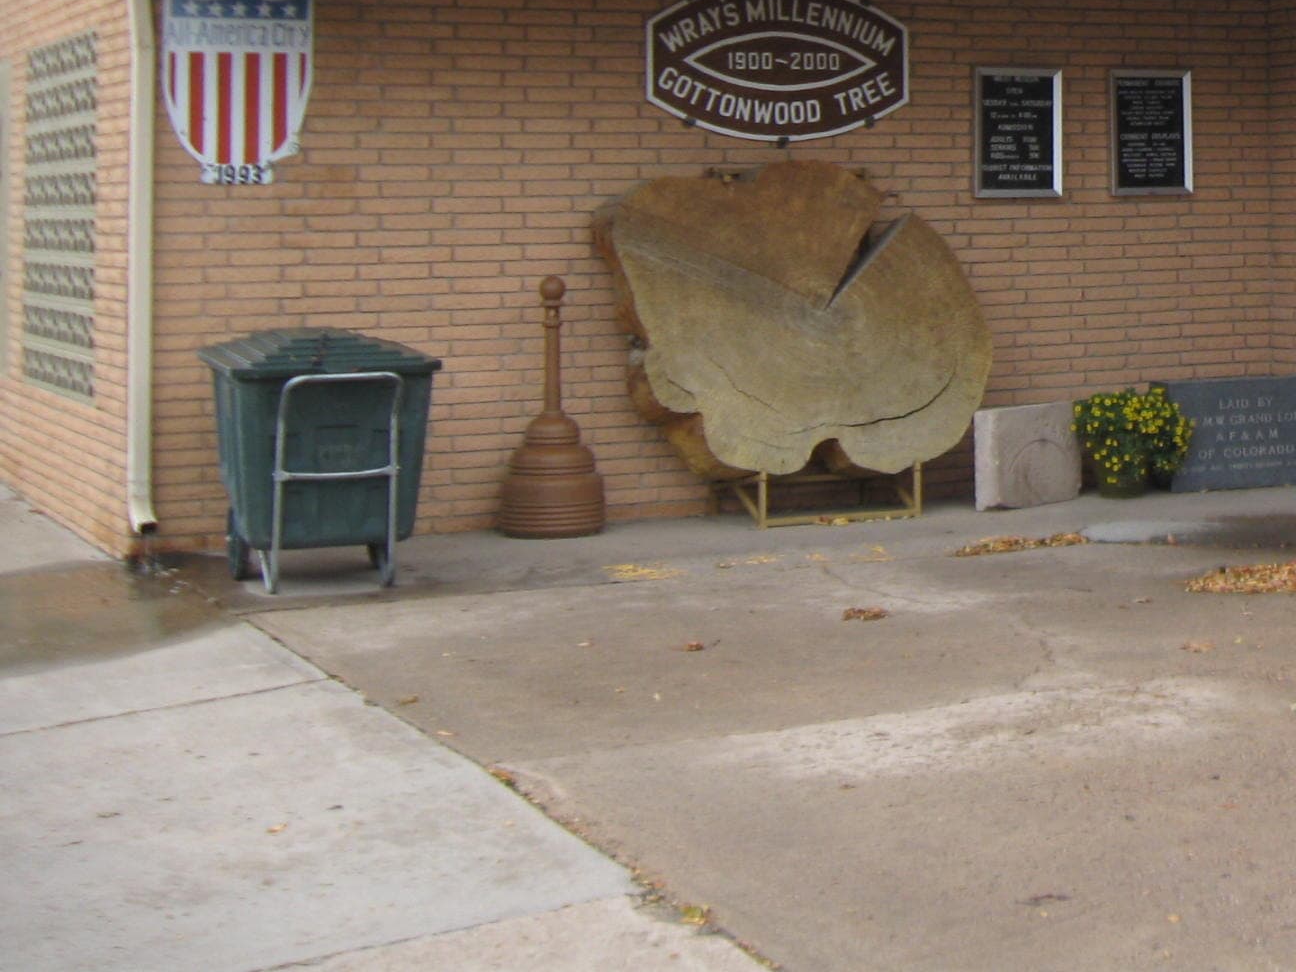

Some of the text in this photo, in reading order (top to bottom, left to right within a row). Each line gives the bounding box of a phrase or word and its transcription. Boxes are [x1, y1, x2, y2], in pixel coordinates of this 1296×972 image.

[833, 71, 896, 116] TREE
[214, 163, 264, 184] 1993
[1257, 396, 1273, 408] BY
